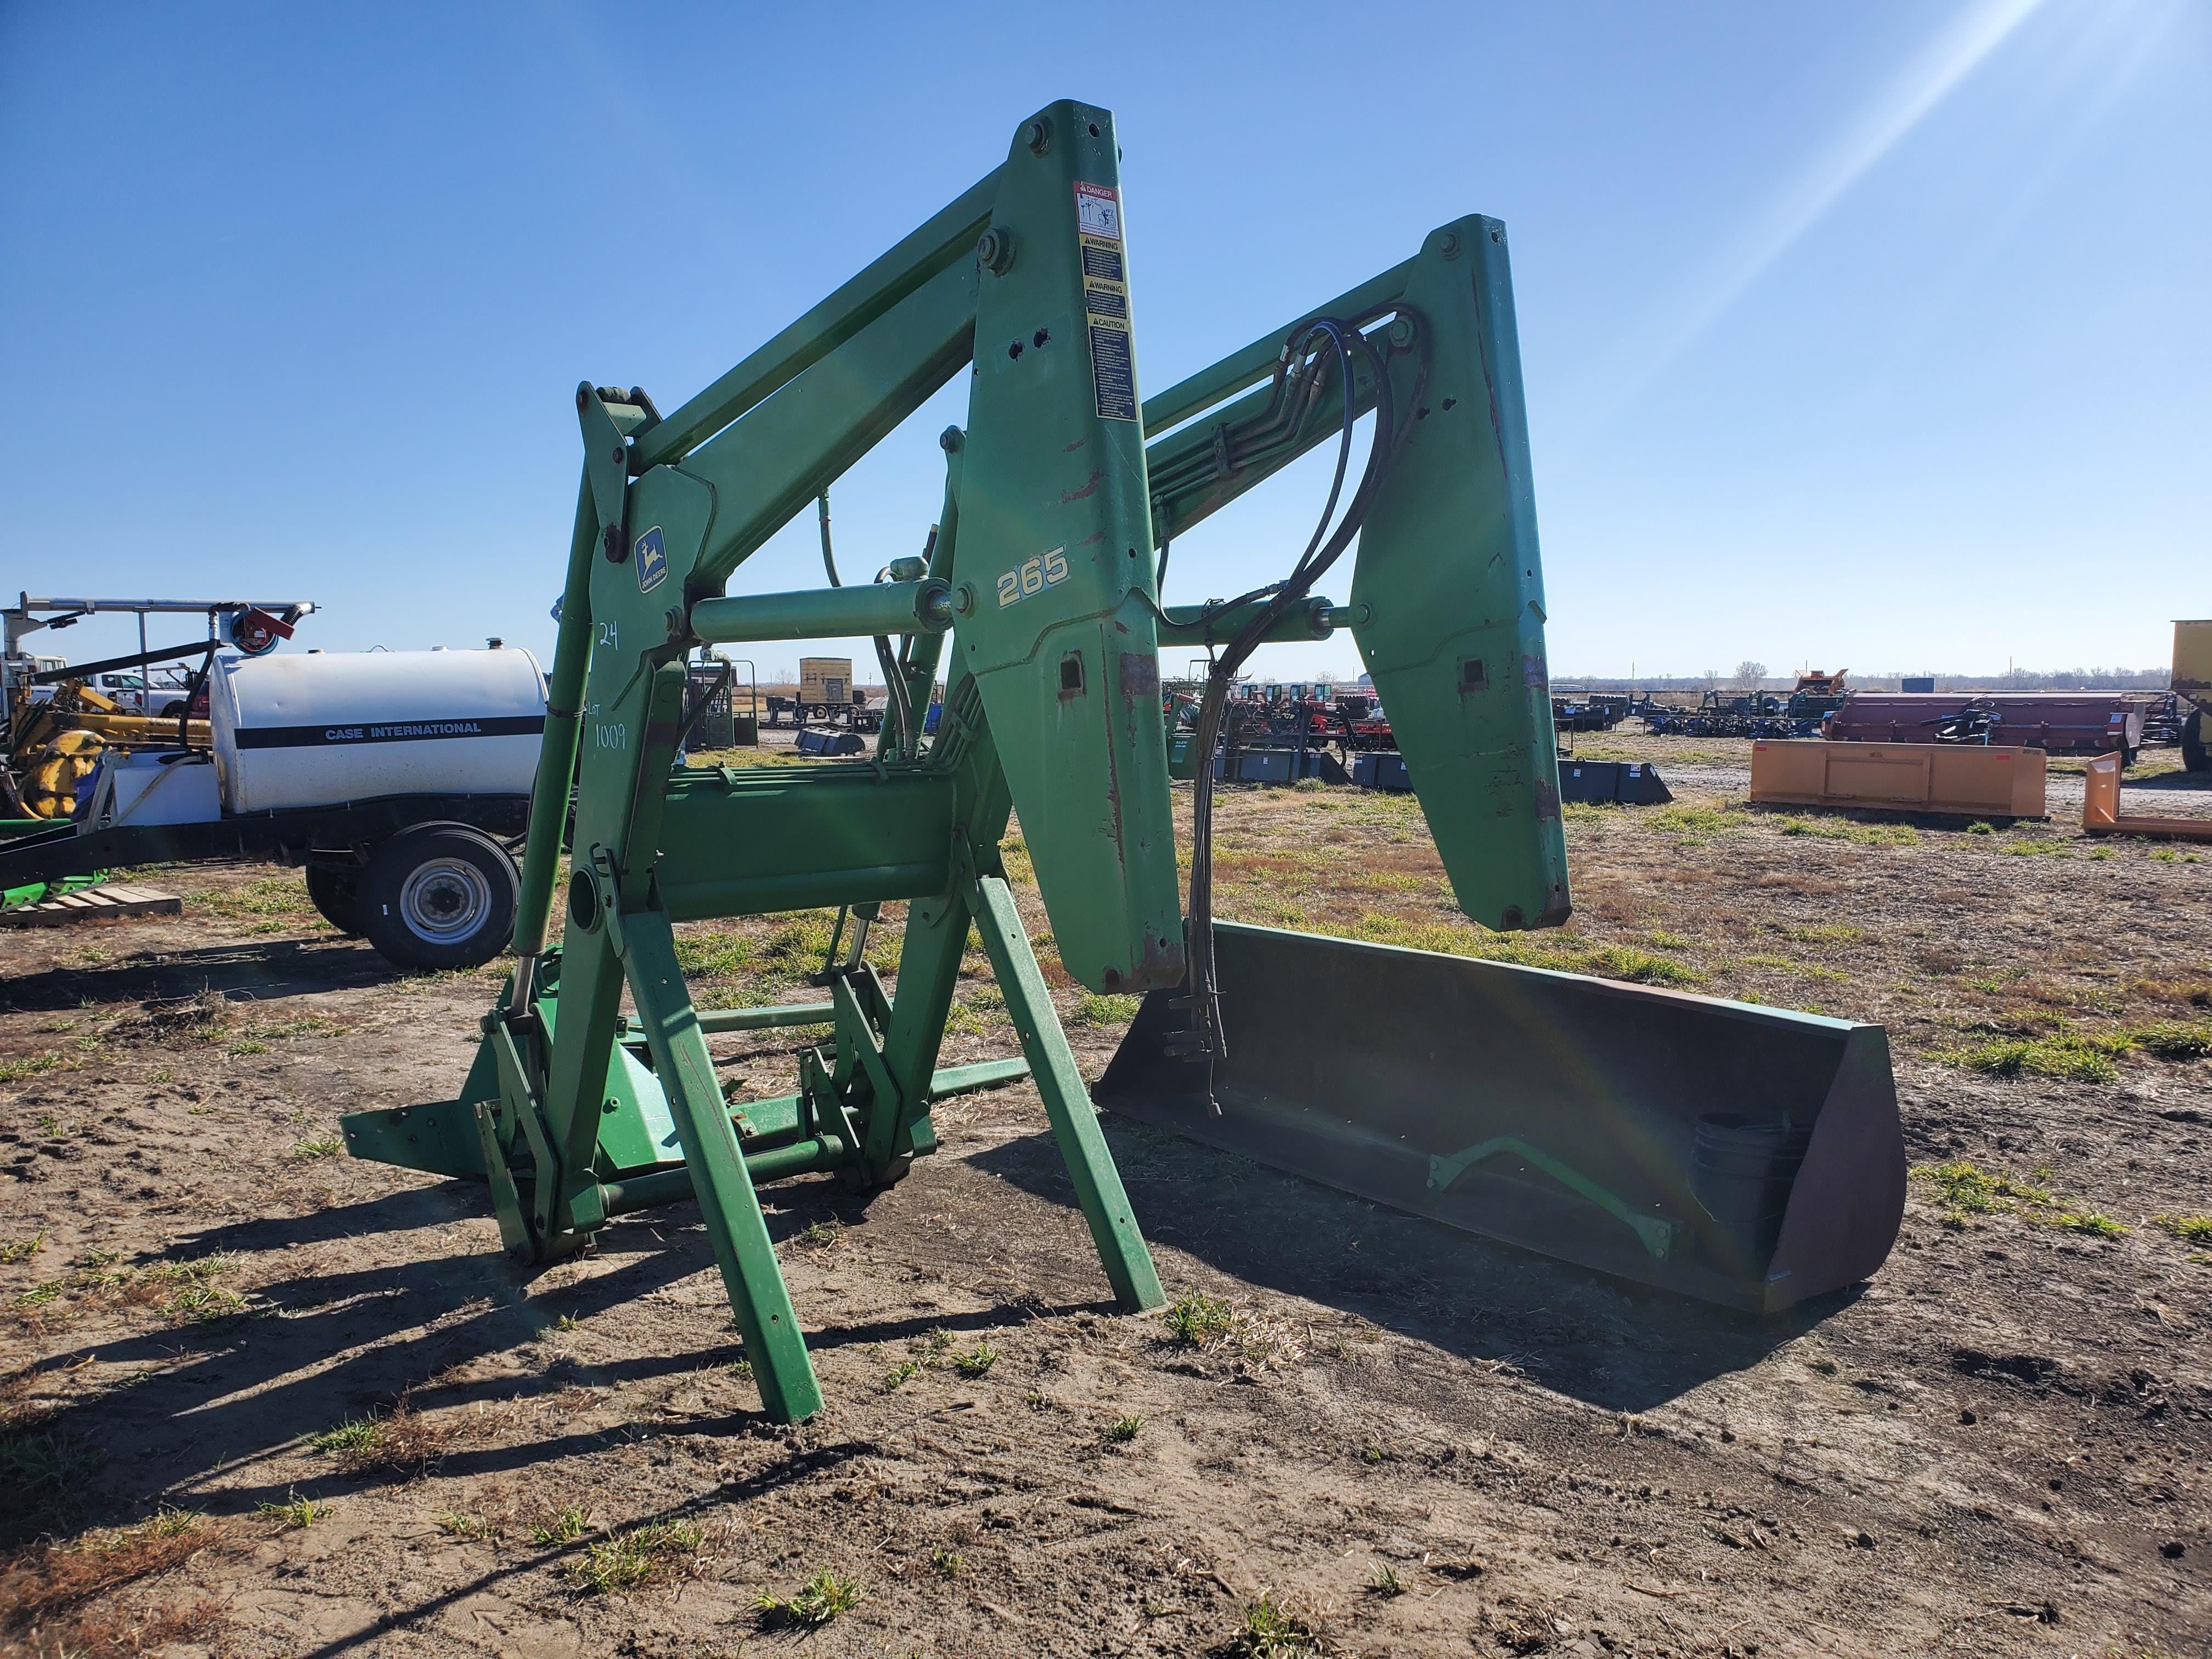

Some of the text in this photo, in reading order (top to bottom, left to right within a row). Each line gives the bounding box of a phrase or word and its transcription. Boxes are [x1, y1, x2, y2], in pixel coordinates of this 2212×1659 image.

[1087, 185, 1112, 198] DANGER
[1090, 239, 1118, 251] WARNING
[1094, 281, 1122, 294] WARNING
[1098, 318, 1125, 329] CAUTION
[642, 566, 667, 589] JOHN DEERE
[997, 545, 1069, 608] 265
[599, 620, 618, 651] 24
[325, 722, 482, 740] CASE INTERNATIONAL
[596, 723, 626, 750] 1009
